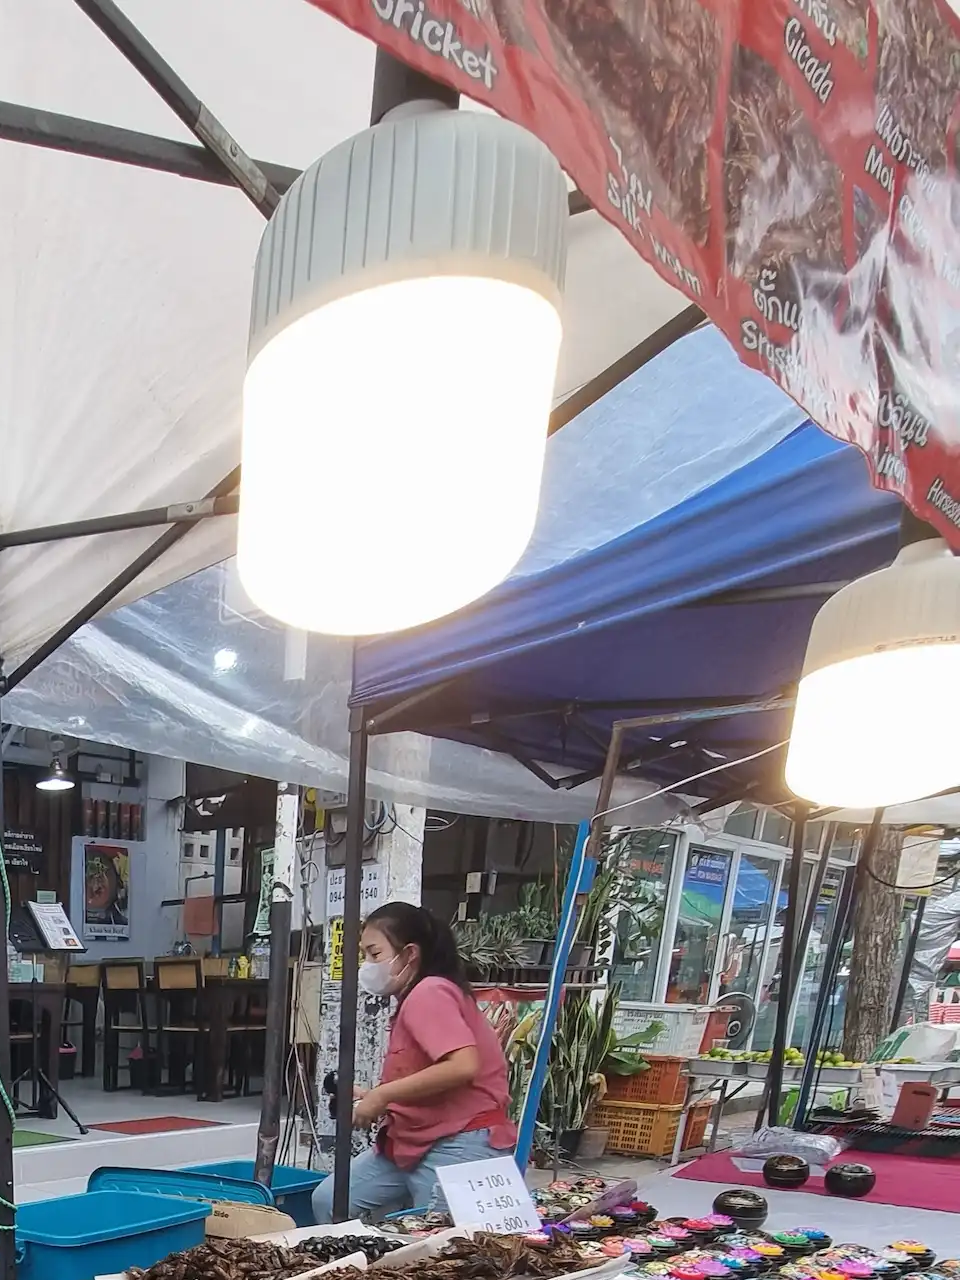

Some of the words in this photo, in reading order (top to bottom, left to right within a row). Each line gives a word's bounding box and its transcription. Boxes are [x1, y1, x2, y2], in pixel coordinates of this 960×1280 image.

[784, 17, 834, 104] Cicada
[485, 1174, 505, 1189] 100
[476, 1200, 485, 1214] 5
[494, 1195, 514, 1209] 450
